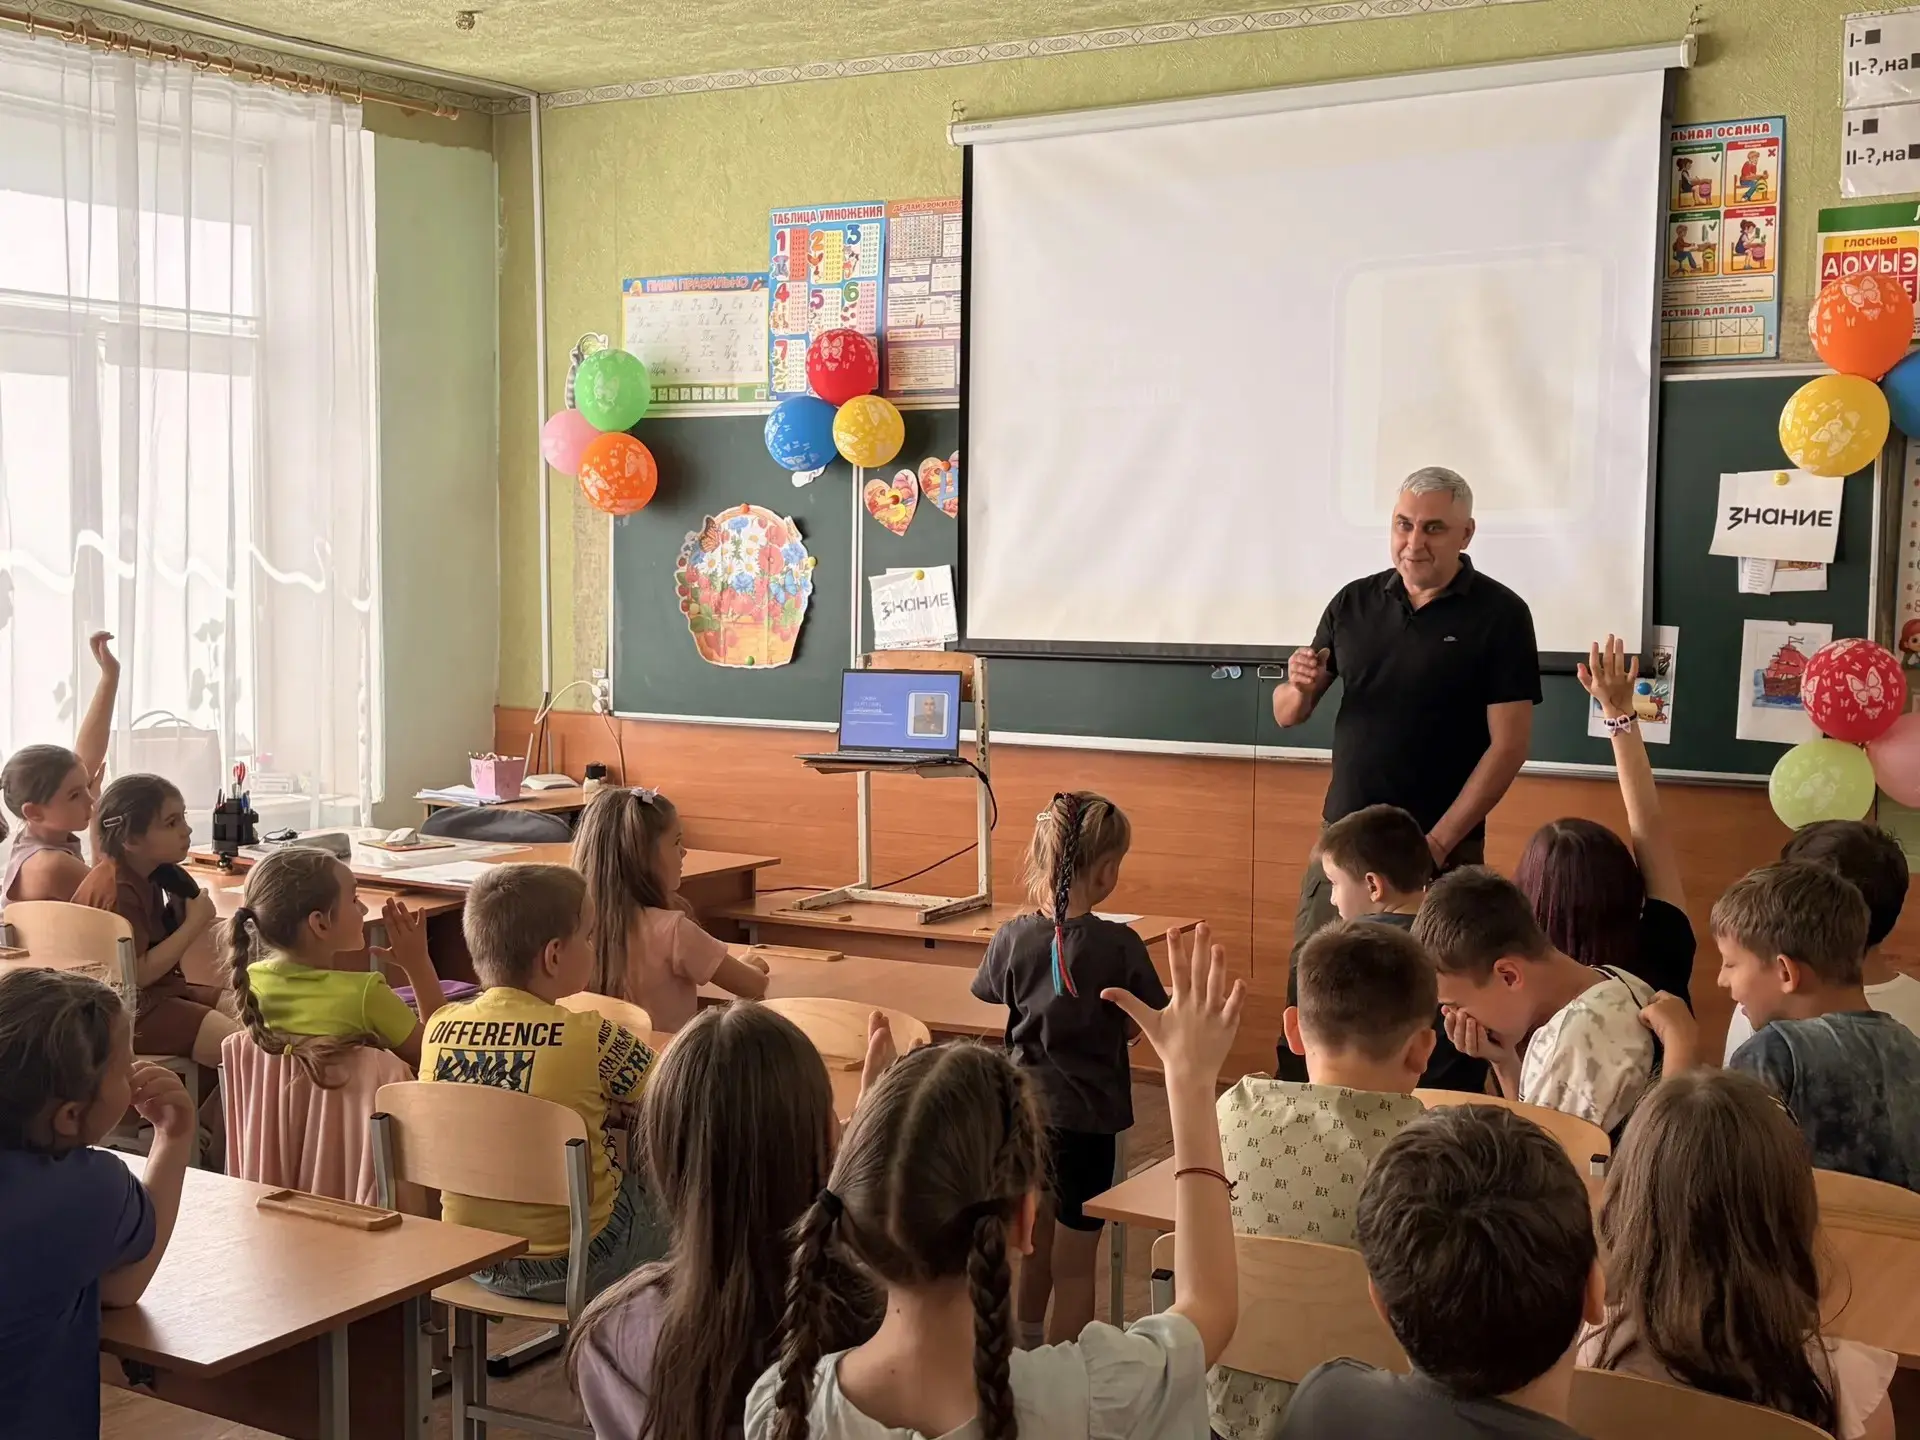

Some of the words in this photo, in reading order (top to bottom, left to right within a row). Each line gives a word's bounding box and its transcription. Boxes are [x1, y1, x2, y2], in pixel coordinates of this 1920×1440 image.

[1717, 123, 1770, 137] ОСАНКА
[773, 211, 817, 224] ТАБЛИЦА
[819, 206, 883, 221] УМНОЖЕНИЯ
[922, 201, 947, 209] УРОКИ
[776, 231, 786, 251] 1
[810, 231, 824, 251] 2
[846, 224, 861, 245] 3
[1844, 235, 1898, 248] гласные
[646, 279, 678, 292] ПИШИ
[679, 276, 748, 290] ПРАВИЛЬНО
[775, 283, 790, 303] 4
[843, 282, 859, 302] 6
[810, 289, 824, 309] 5
[1703, 306, 1725, 316] ДЛЯ
[1728, 305, 1754, 314] ГЛАЗ
[775, 340, 788, 360] 7
[429, 1021, 565, 1046] DIFFERENCE
